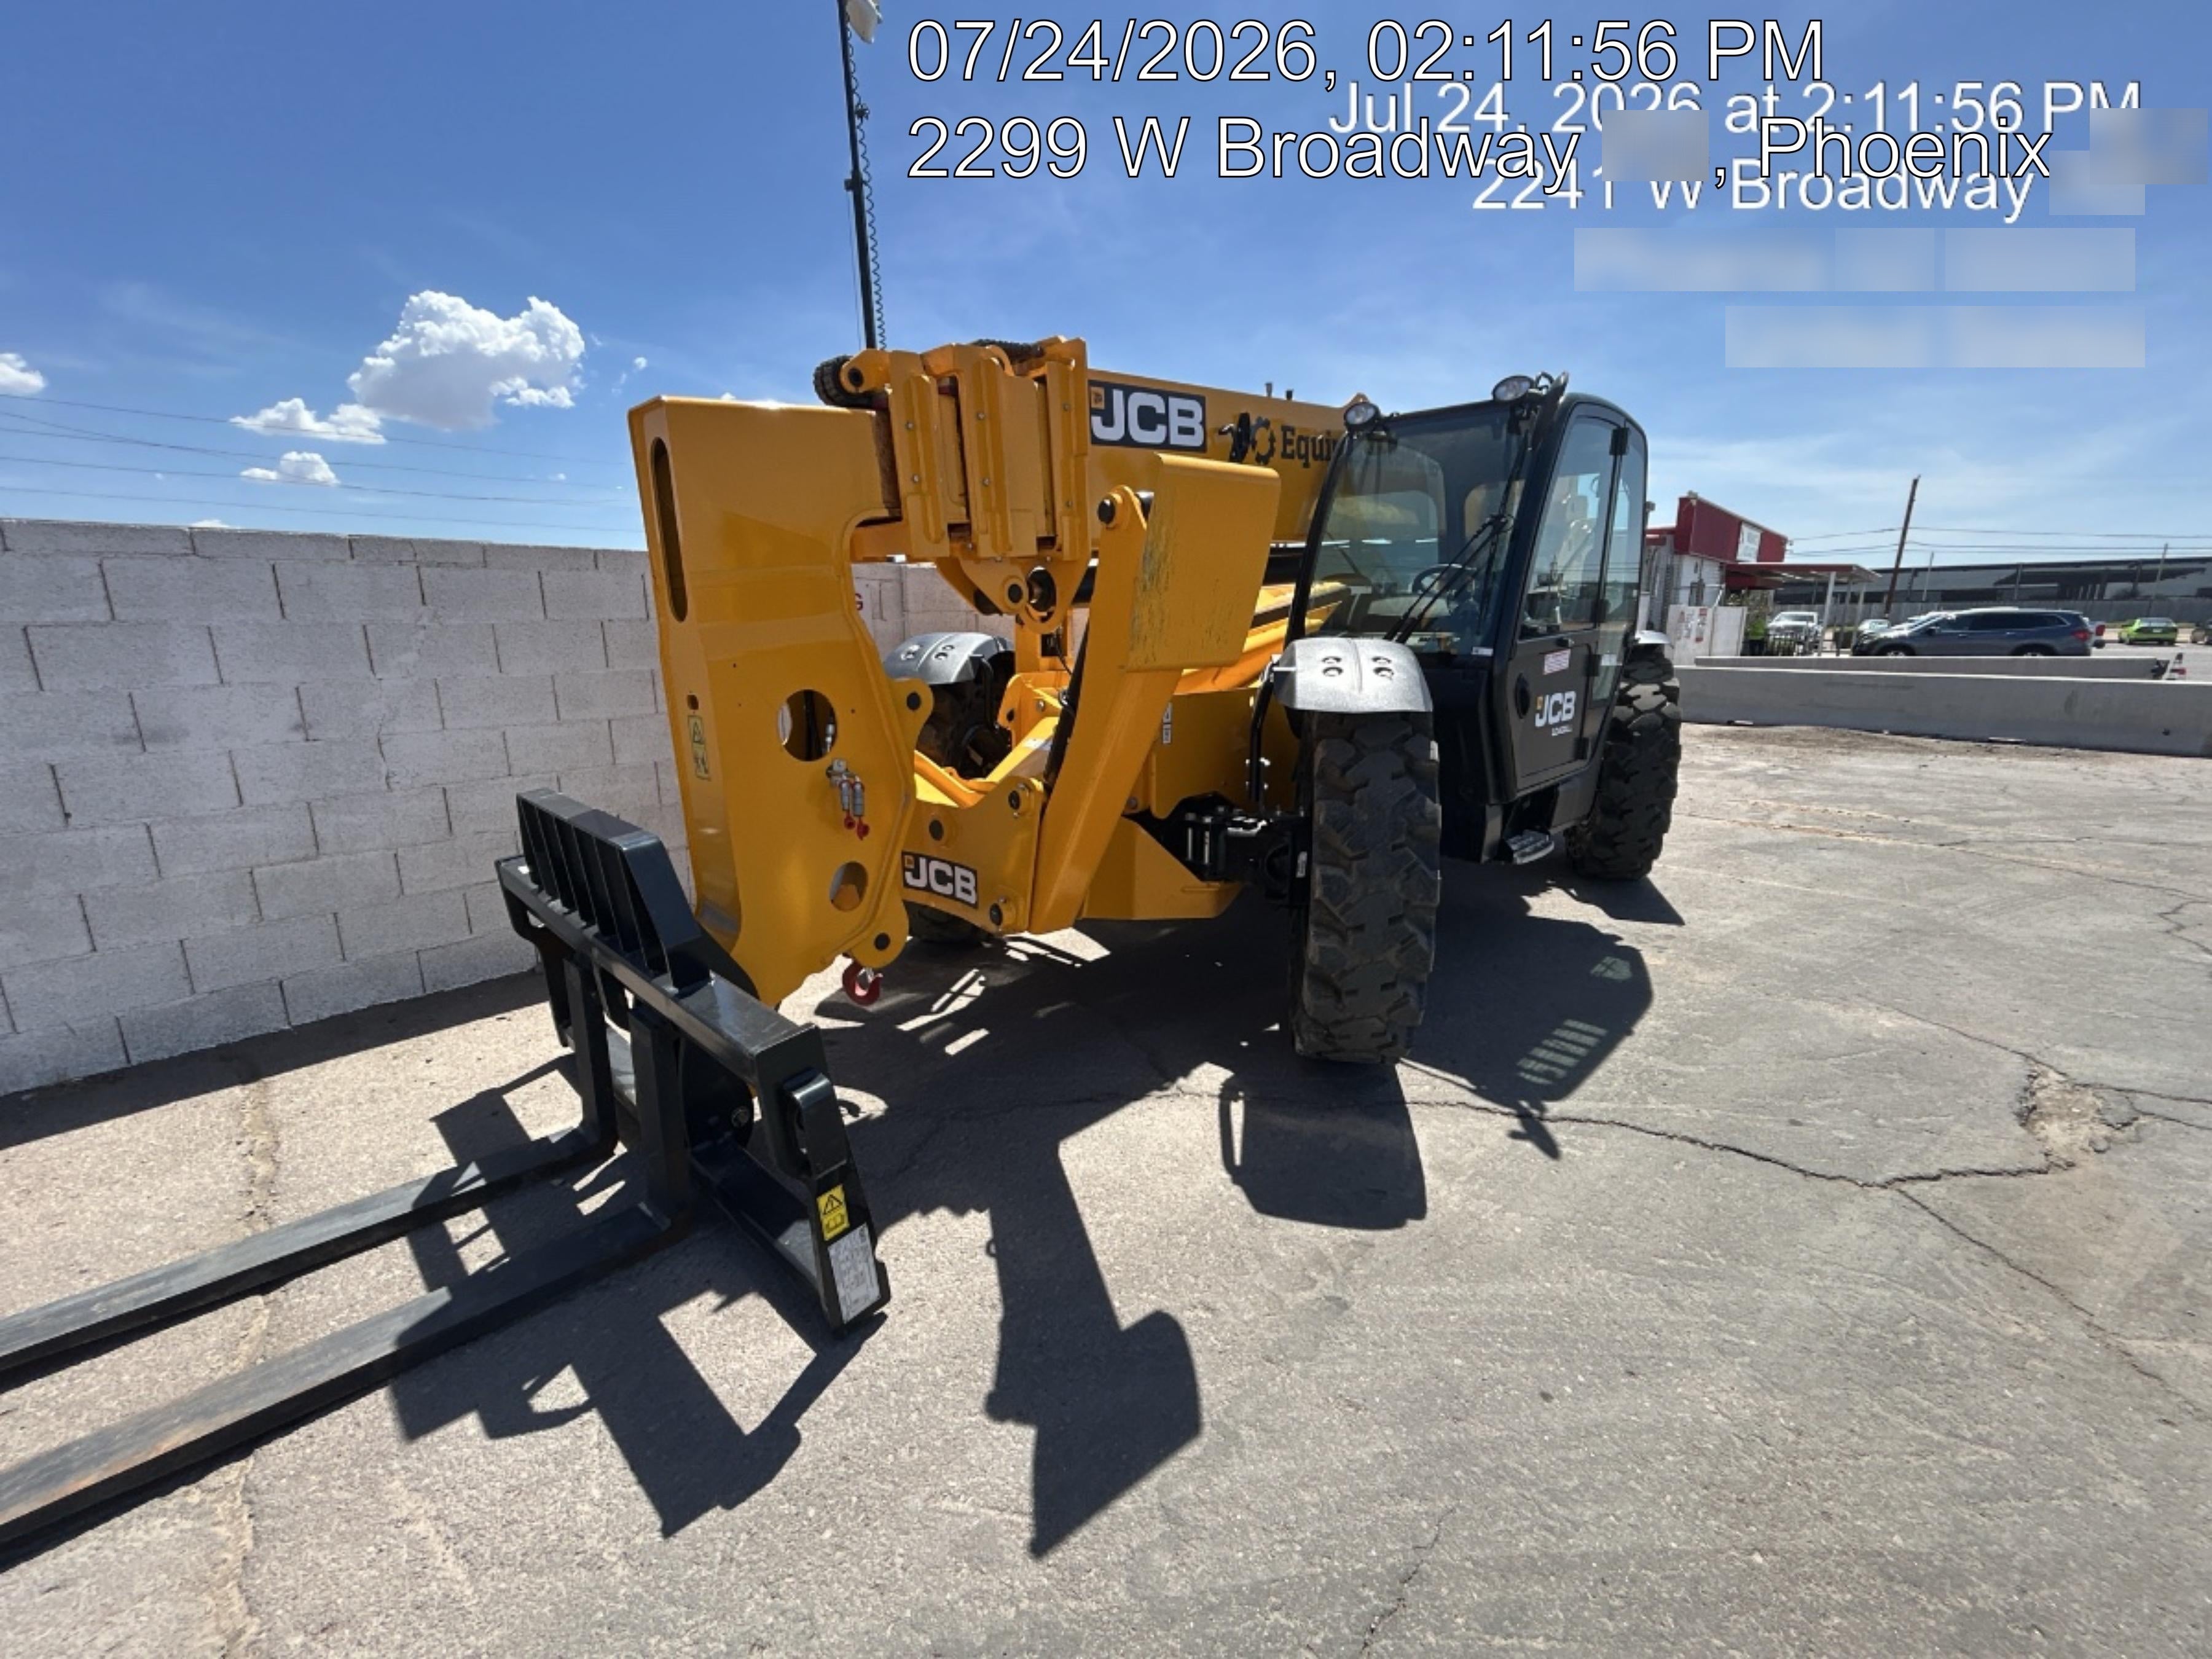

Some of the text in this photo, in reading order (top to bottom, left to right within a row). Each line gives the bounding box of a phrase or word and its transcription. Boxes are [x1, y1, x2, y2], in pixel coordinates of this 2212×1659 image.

[1091, 388, 1205, 447] JCB
[1535, 691, 1577, 728] JCB
[904, 857, 977, 904] JCB
